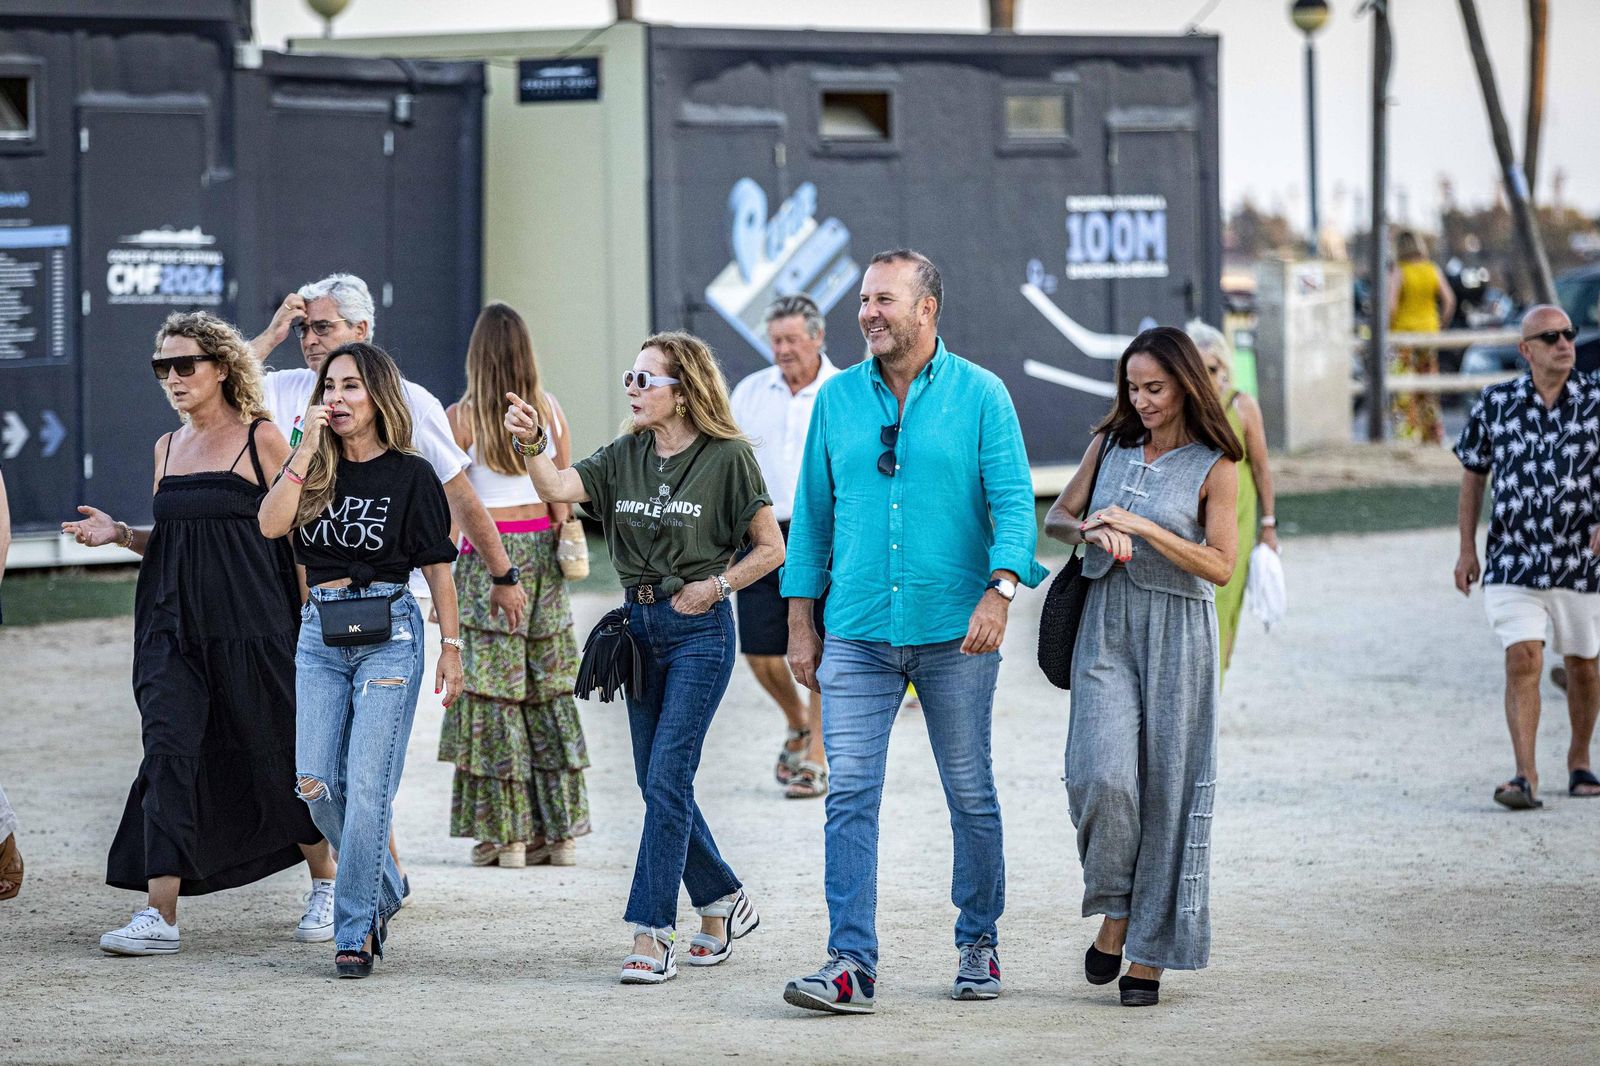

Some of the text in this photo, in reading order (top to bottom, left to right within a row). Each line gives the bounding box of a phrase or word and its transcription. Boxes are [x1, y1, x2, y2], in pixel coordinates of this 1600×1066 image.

[1065, 211, 1167, 263] 100M
[319, 496, 391, 523] MPLE
[615, 500, 662, 518] SIMPLE
[348, 624, 361, 633] MK
